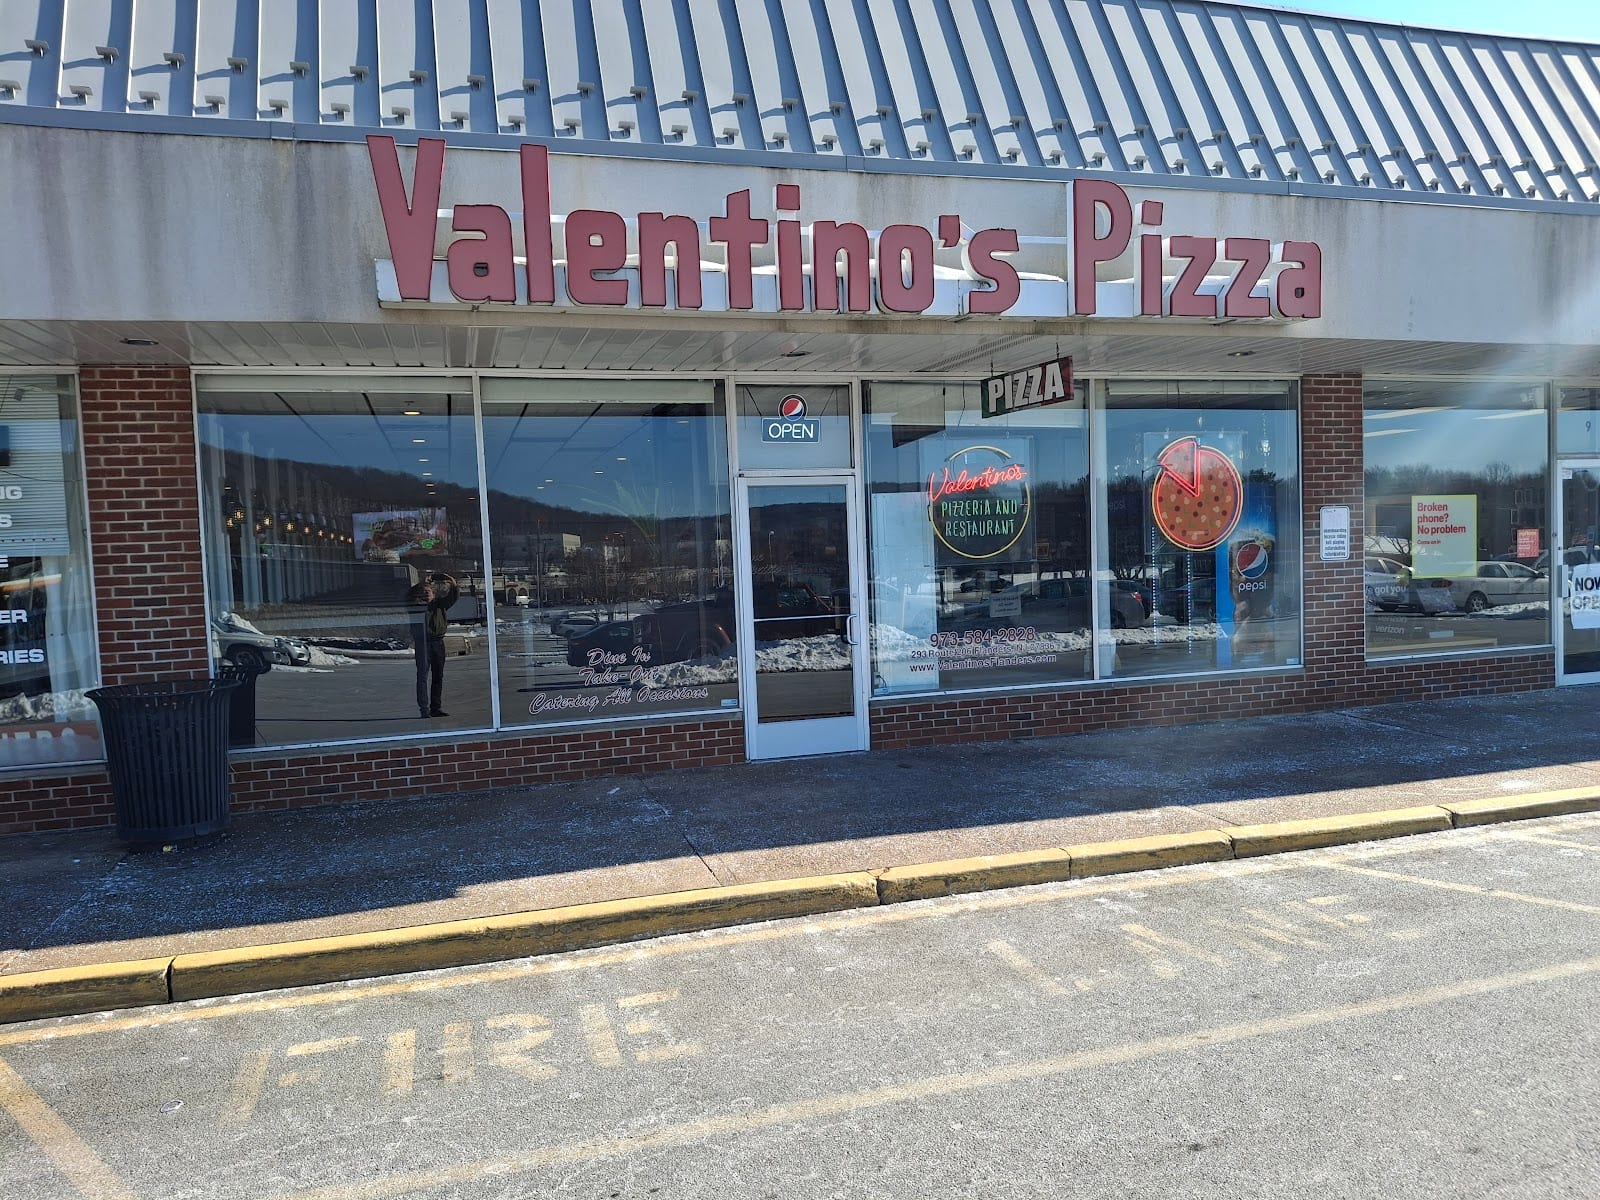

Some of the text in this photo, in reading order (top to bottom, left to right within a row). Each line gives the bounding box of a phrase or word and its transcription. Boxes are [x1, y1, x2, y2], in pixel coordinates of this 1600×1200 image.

[366, 135, 1322, 319] Valentino's Pizza
[987, 361, 1065, 413] PIZZA
[768, 422, 814, 439] OPEN
[995, 499, 1018, 515] AND
[1417, 502, 1448, 512] Broken
[1417, 513, 1449, 525] phone?
[945, 519, 1015, 537] RESTAURANT
[1417, 524, 1466, 536] No problem
[1238, 581, 1268, 593] pepsi
[1375, 584, 1389, 597] got
[1391, 585, 1406, 596] you
[930, 627, 1035, 648] 973-584-2828
[1375, 625, 1404, 634] verizon
[587, 648, 628, 667] Dine
[909, 654, 1057, 672] www.ValentinosFlanders.com
[911, 650, 927, 659] 293
[579, 665, 660, 686] Take-Out
[529, 693, 600, 715] Catering
[602, 688, 632, 706] All
[636, 686, 709, 703] Occasions
[215, 989, 706, 1128] FIRE
